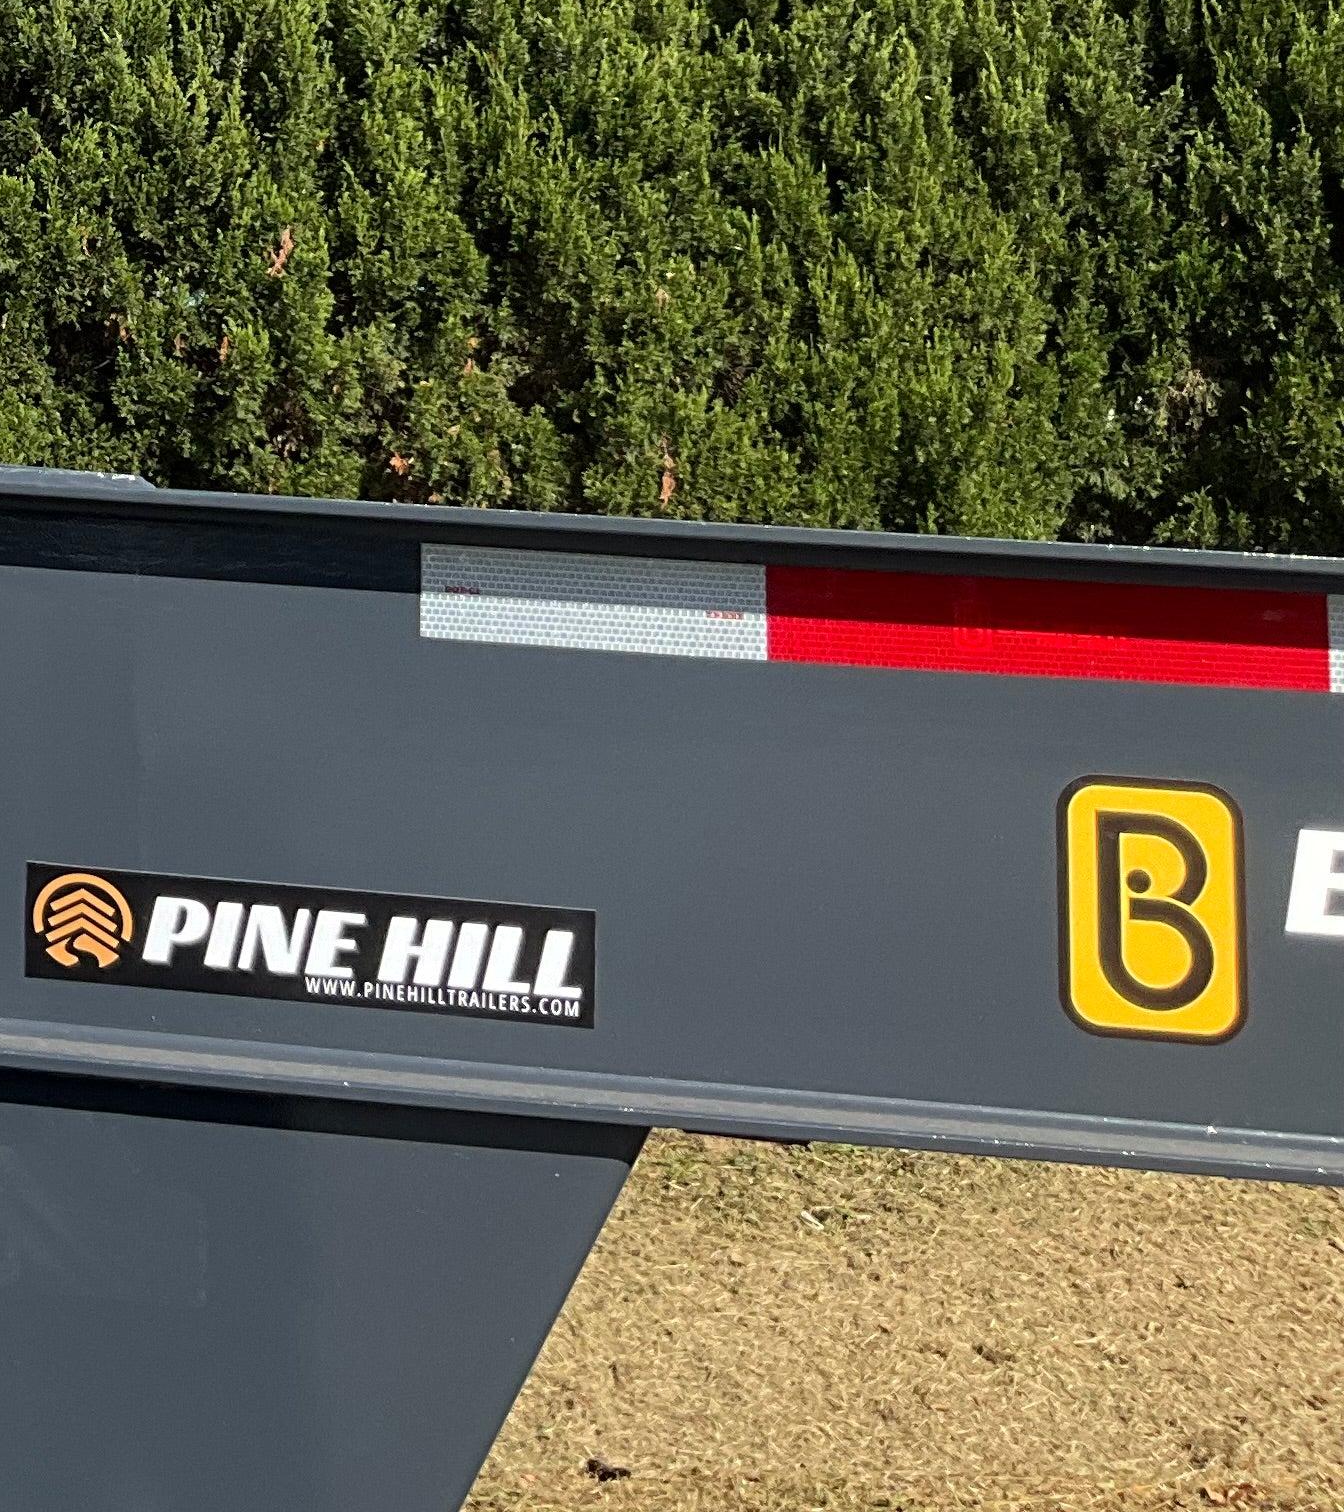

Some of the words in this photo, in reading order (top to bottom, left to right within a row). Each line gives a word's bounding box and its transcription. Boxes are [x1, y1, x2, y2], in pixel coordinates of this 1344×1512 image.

[142, 895, 366, 977] PINE
[376, 915, 583, 999] HILL
[304, 976, 581, 1018] WWW.PINEHILLTRAILERS.COM
